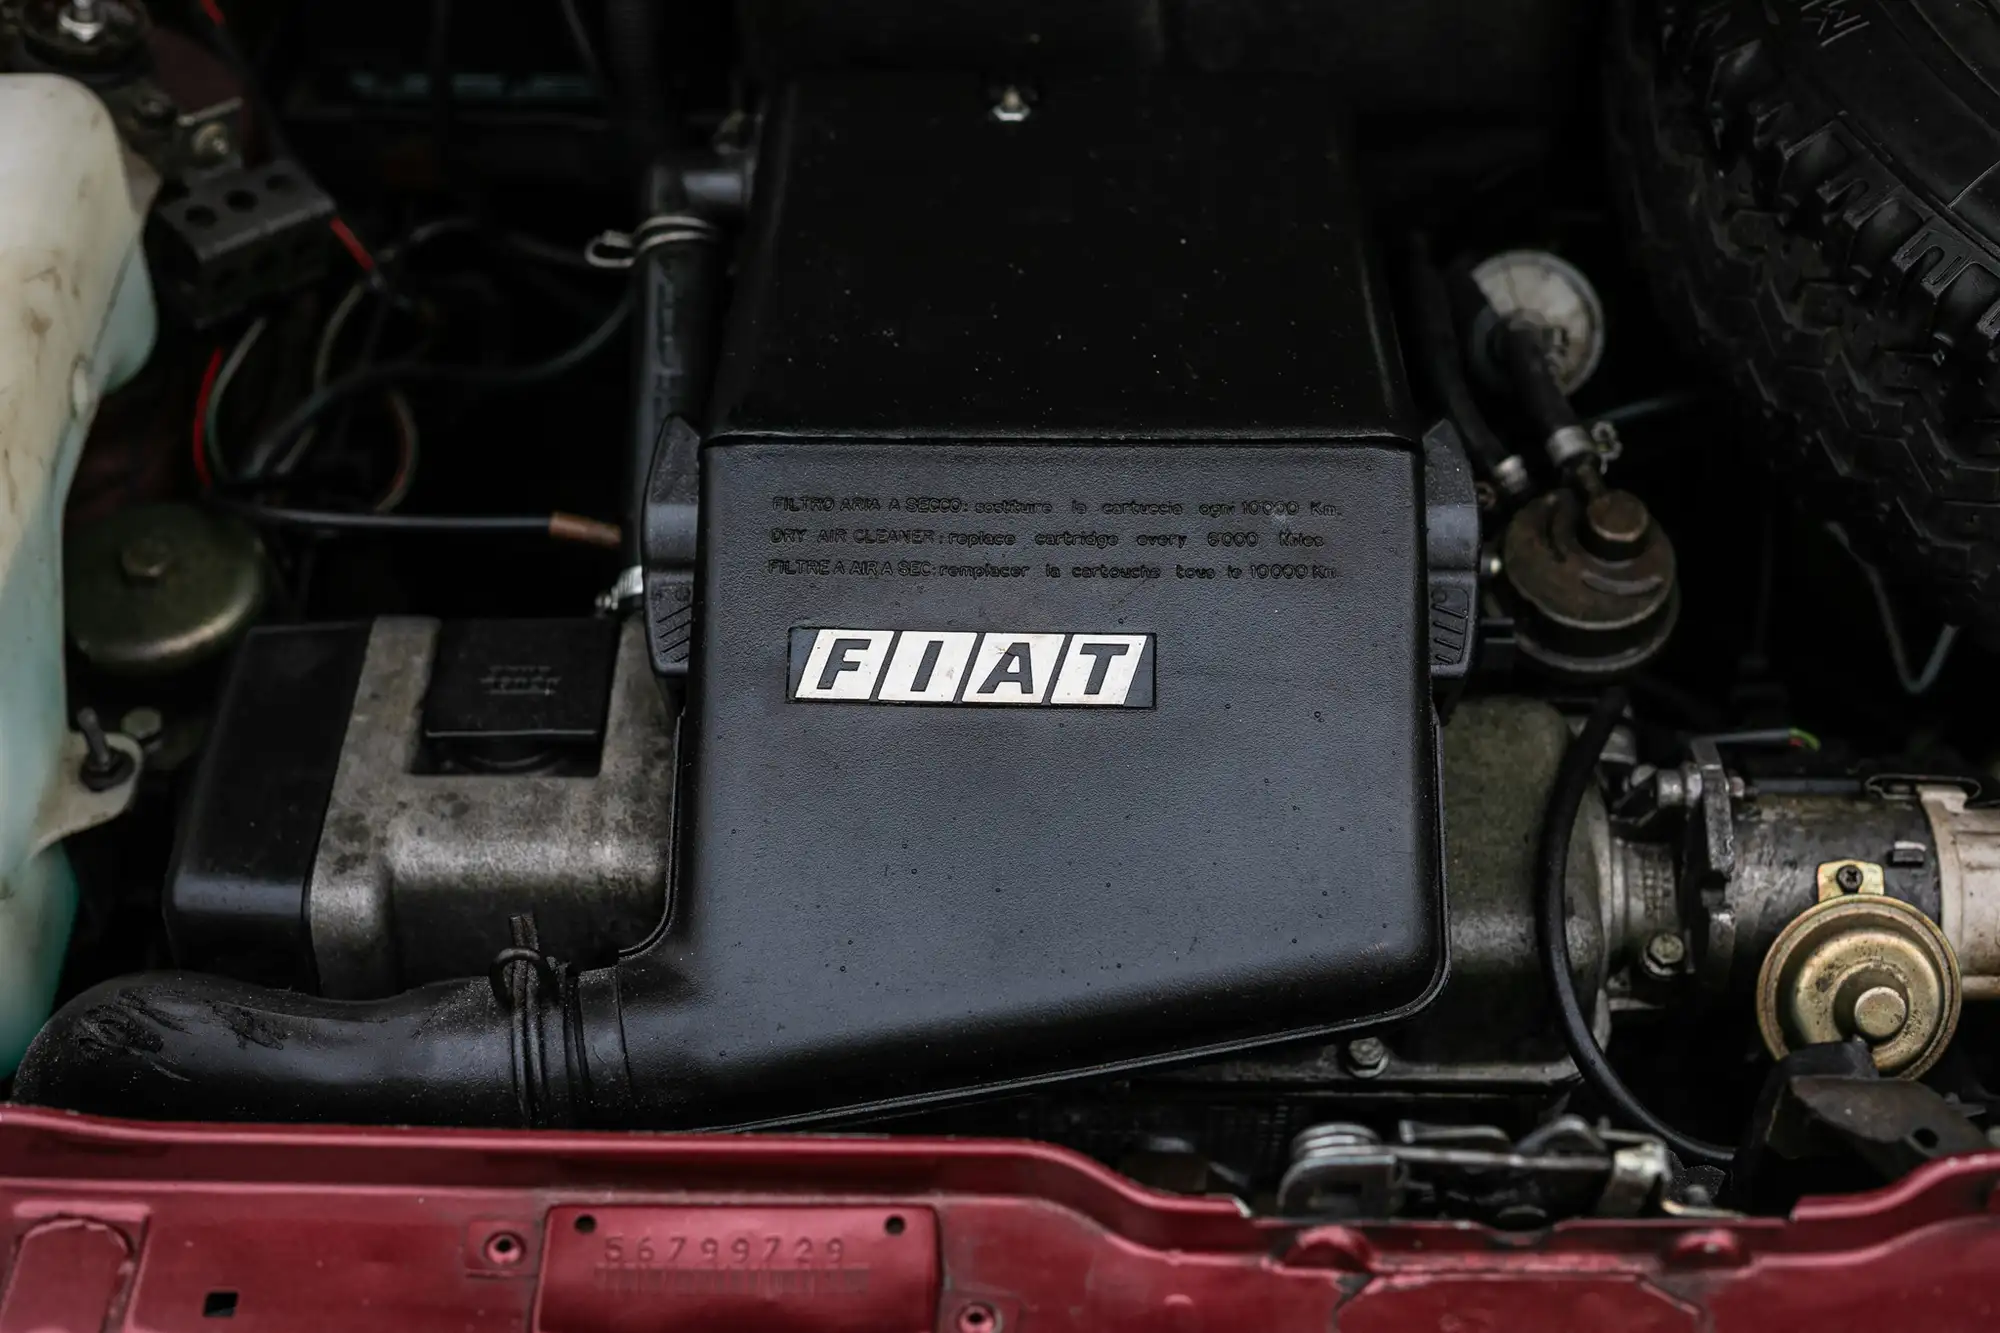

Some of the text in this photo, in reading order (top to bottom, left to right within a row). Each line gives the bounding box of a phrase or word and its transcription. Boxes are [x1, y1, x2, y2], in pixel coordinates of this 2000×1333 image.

[772, 496, 834, 512] FILTRO
[840, 497, 880, 512] ARIA
[889, 498, 901, 512] A
[769, 528, 806, 544] DRY
[817, 529, 848, 544] AIR
[949, 531, 1016, 548] replace
[1034, 531, 1119, 549] cartridge
[1136, 534, 1187, 549] every
[768, 559, 830, 575] FILTRE
[833, 560, 845, 575] A
[849, 560, 878, 576] AIR
[880, 560, 893, 576] A
[939, 563, 1030, 580] remplacer
[1071, 564, 1161, 579] cartouche
[1176, 564, 1216, 579] tous
[815, 637, 1130, 696] FIAT
